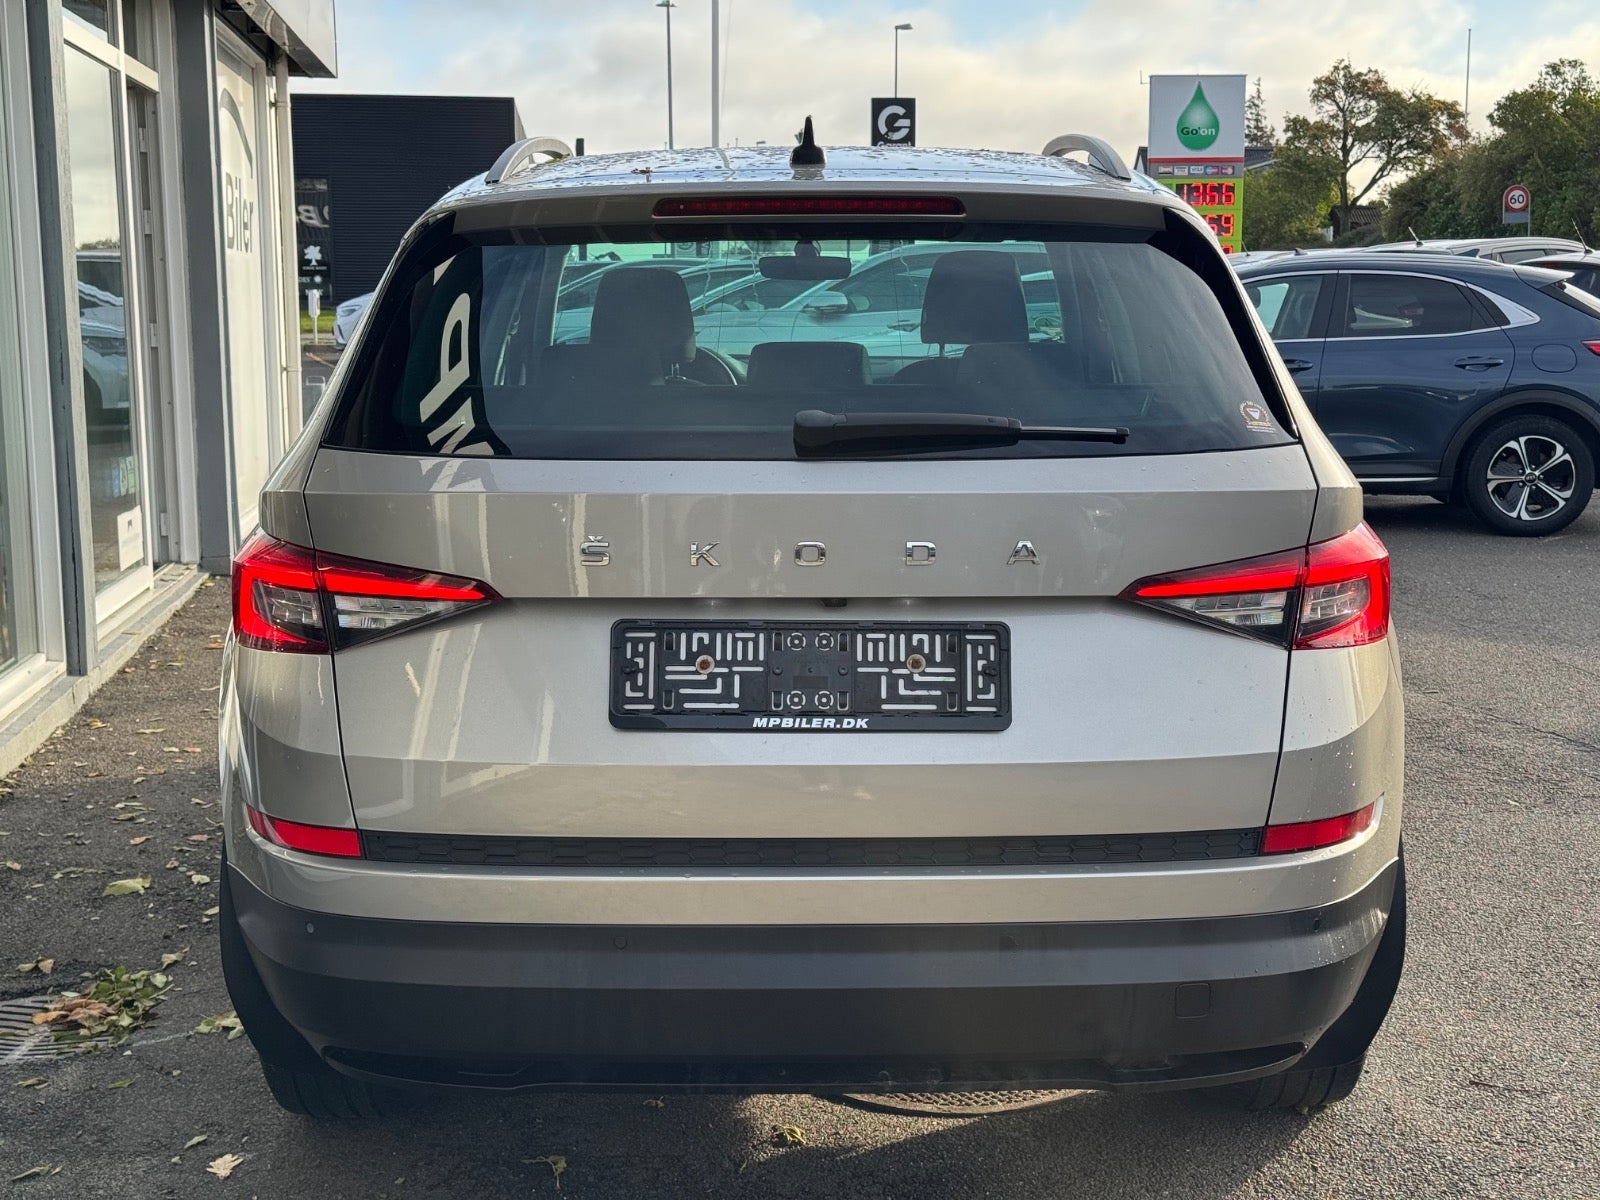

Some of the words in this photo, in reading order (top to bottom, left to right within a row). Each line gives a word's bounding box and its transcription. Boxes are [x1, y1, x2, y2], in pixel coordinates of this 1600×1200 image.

[1510, 194, 1525, 204] 60
[226, 172, 253, 253] Biler
[752, 717, 870, 729] MPBILER.DK
